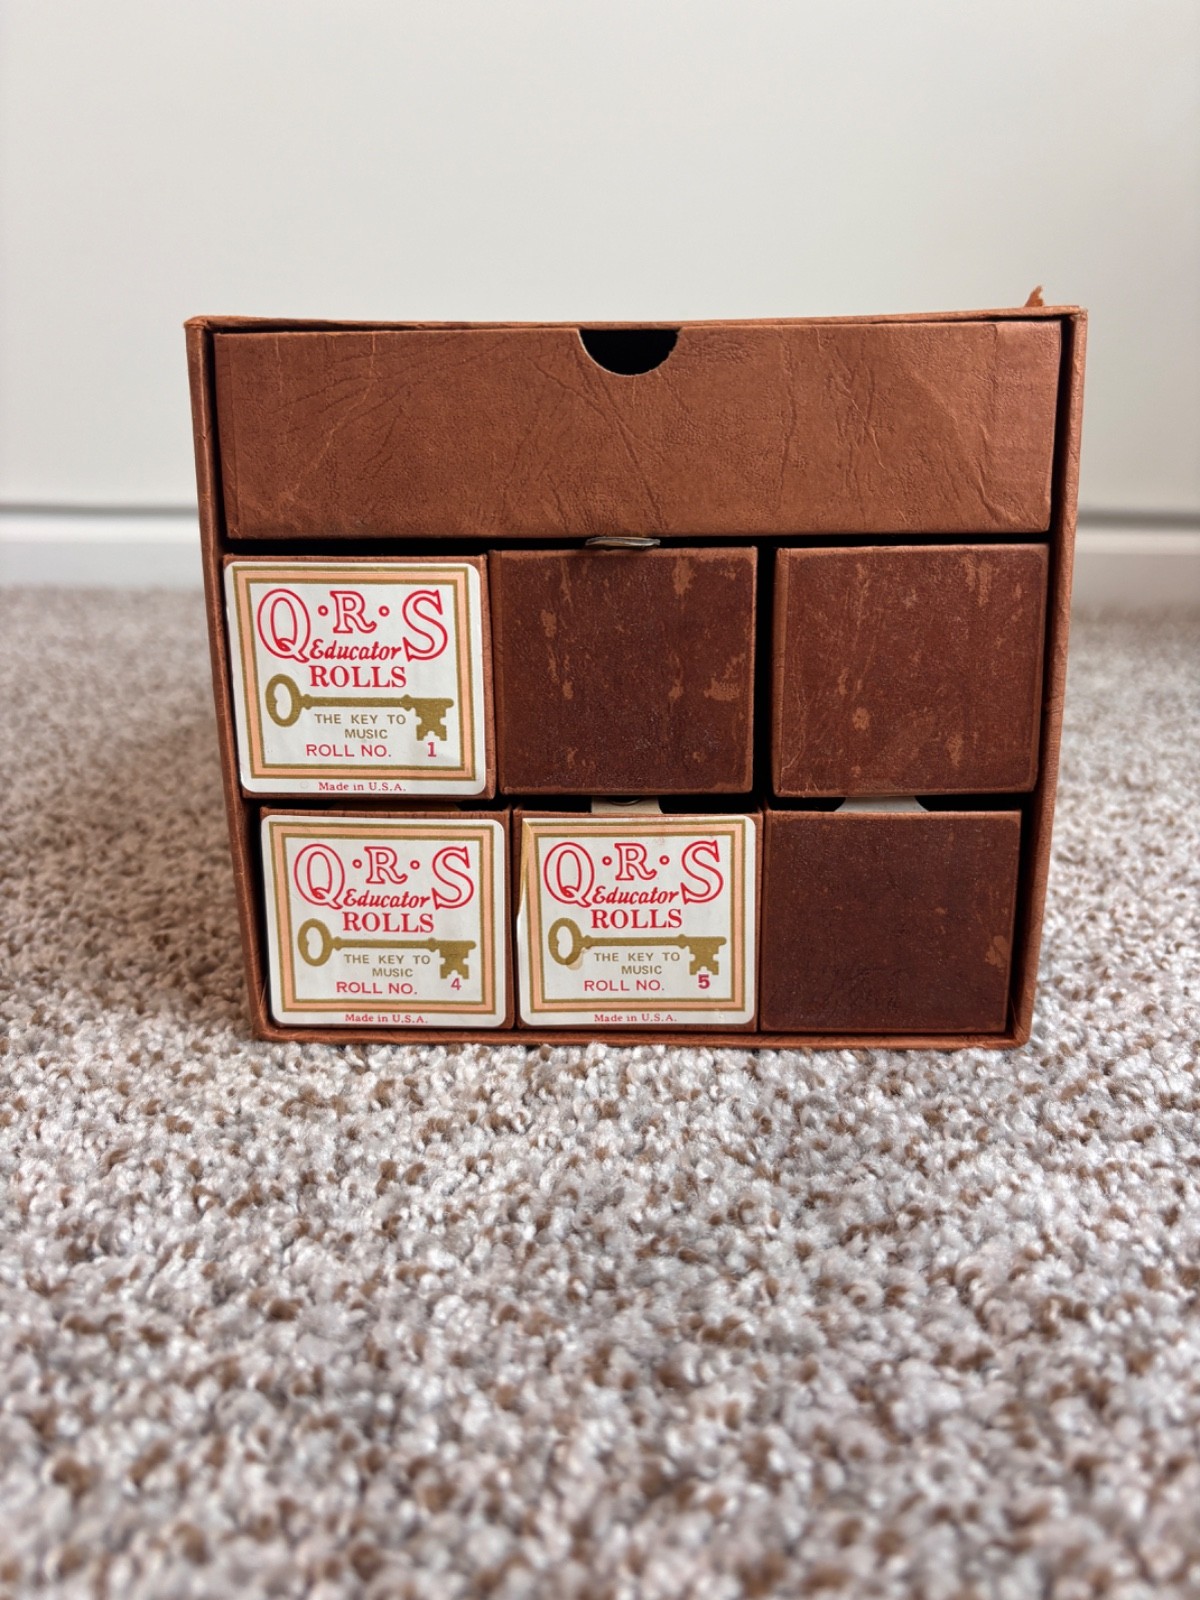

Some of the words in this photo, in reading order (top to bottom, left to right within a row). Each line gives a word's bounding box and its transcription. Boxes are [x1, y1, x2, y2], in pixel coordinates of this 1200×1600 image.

[310, 639, 402, 660] Educator
[309, 666, 406, 688] ROLLS
[315, 714, 341, 724] THE
[351, 715, 378, 724] KEY
[387, 715, 406, 725] TO
[345, 729, 388, 739] MUSIC
[306, 744, 354, 757] ROLL
[361, 745, 392, 757] NO.
[427, 742, 437, 757] 1
[318, 782, 349, 791] Made
[353, 783, 364, 791] in
[369, 783, 406, 792] U.S.A.
[343, 889, 431, 908] Educator
[592, 886, 680, 905] Educator
[342, 912, 434, 933] ROLLS
[590, 908, 682, 929] ROLLS
[344, 954, 369, 964] THE
[379, 955, 404, 964] KEY
[413, 955, 431, 965] TO
[594, 953, 619, 962] THE
[628, 952, 653, 962] KEY
[663, 952, 680, 962] TO
[372, 968, 413, 977] MUSIC
[621, 965, 662, 974] MUSIC
[336, 982, 382, 993] ROLL
[388, 983, 417, 994] NO.
[450, 978, 461, 990] 4
[584, 980, 629, 992] ROLL
[636, 980, 664, 991] NO.
[698, 974, 710, 989] 5
[378, 1014, 388, 1022] in
[392, 1015, 428, 1023] U.S.A.
[594, 1014, 622, 1022] Made
[642, 1013, 677, 1022] U.S.A.
